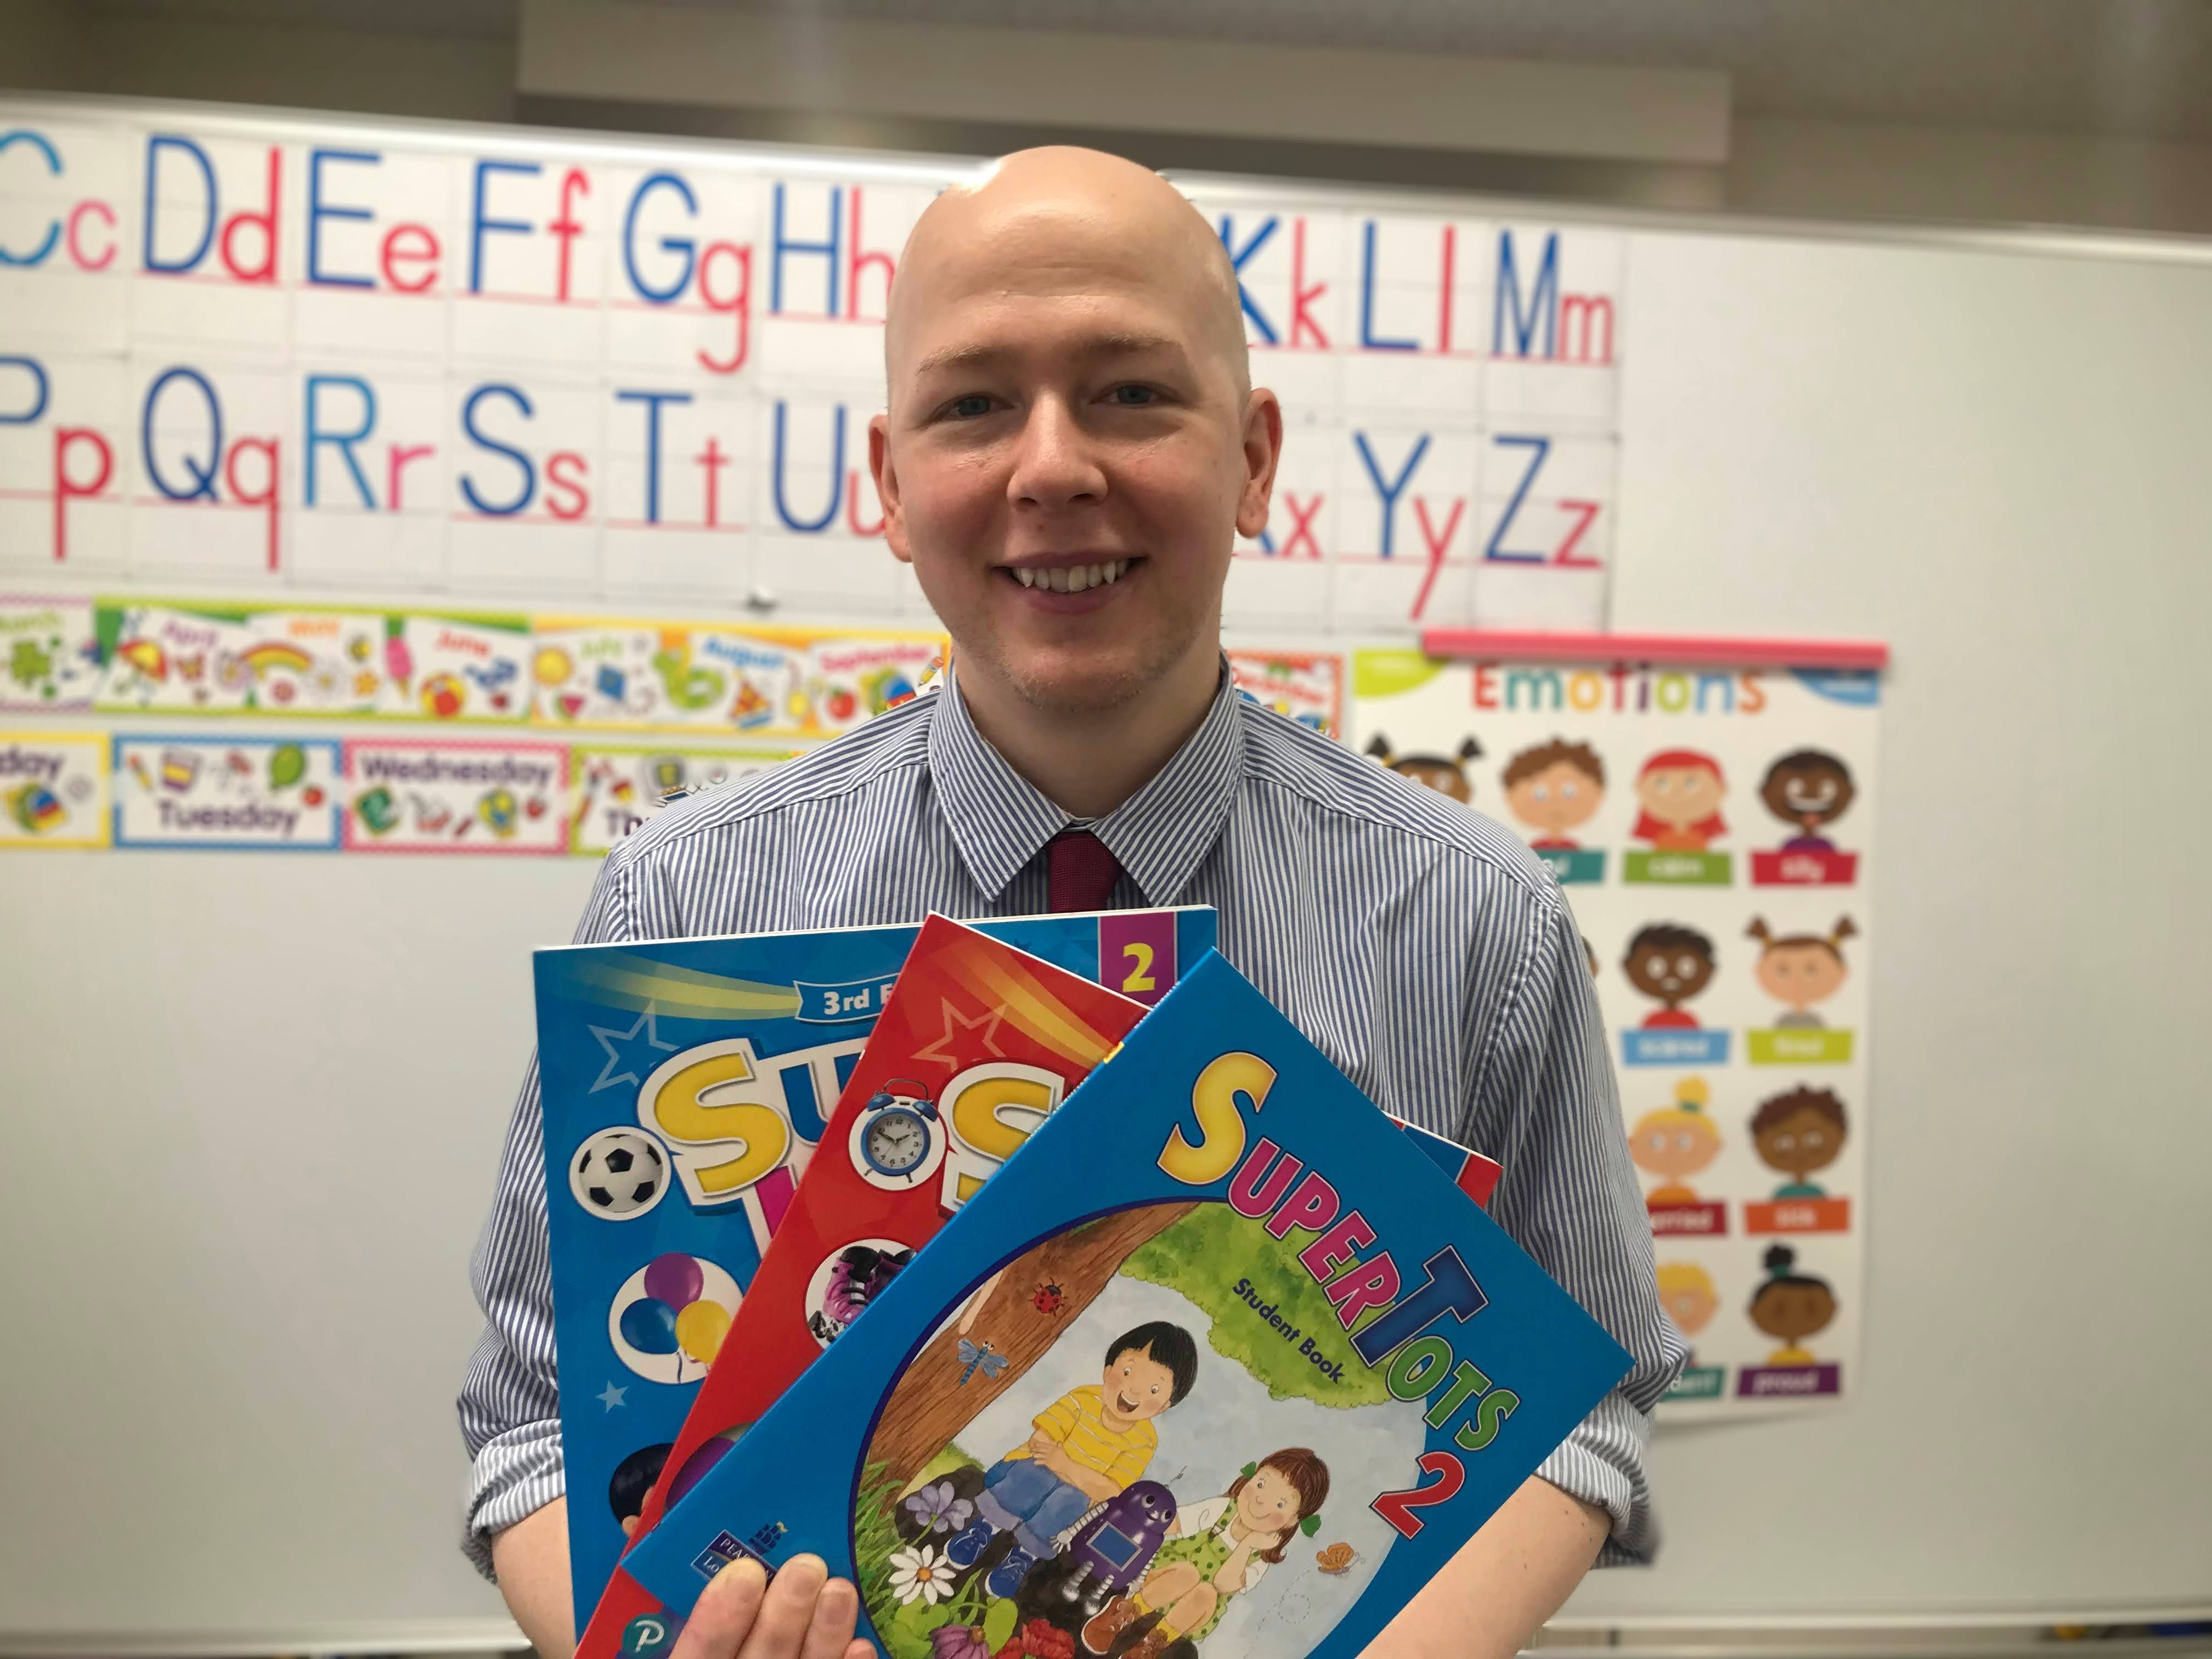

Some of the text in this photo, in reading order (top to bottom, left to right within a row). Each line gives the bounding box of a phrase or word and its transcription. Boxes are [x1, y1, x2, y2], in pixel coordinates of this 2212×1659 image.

[143, 134, 281, 283] Dd
[307, 148, 440, 293] Ee
[469, 159, 590, 302] Ff
[623, 170, 752, 375] Gg
[1493, 230, 1615, 364] Mm
[141, 365, 279, 570] Qq
[304, 375, 436, 511] Rr
[458, 382, 590, 522] Ss
[615, 391, 730, 528] Tt
[1257, 493, 1325, 560] x
[1353, 431, 1467, 620] Yy
[1483, 436, 1603, 567] Zz
[1471, 660, 1768, 713] Emotions
[0, 746, 64, 780] day
[362, 754, 552, 786] Wednesday
[159, 799, 299, 839] Tuesday
[1122, 943, 1156, 992] 2
[824, 988, 870, 1015] 3rd
[1232, 1277, 1345, 1384] Student Book
[1368, 1451, 1465, 1540] 2
